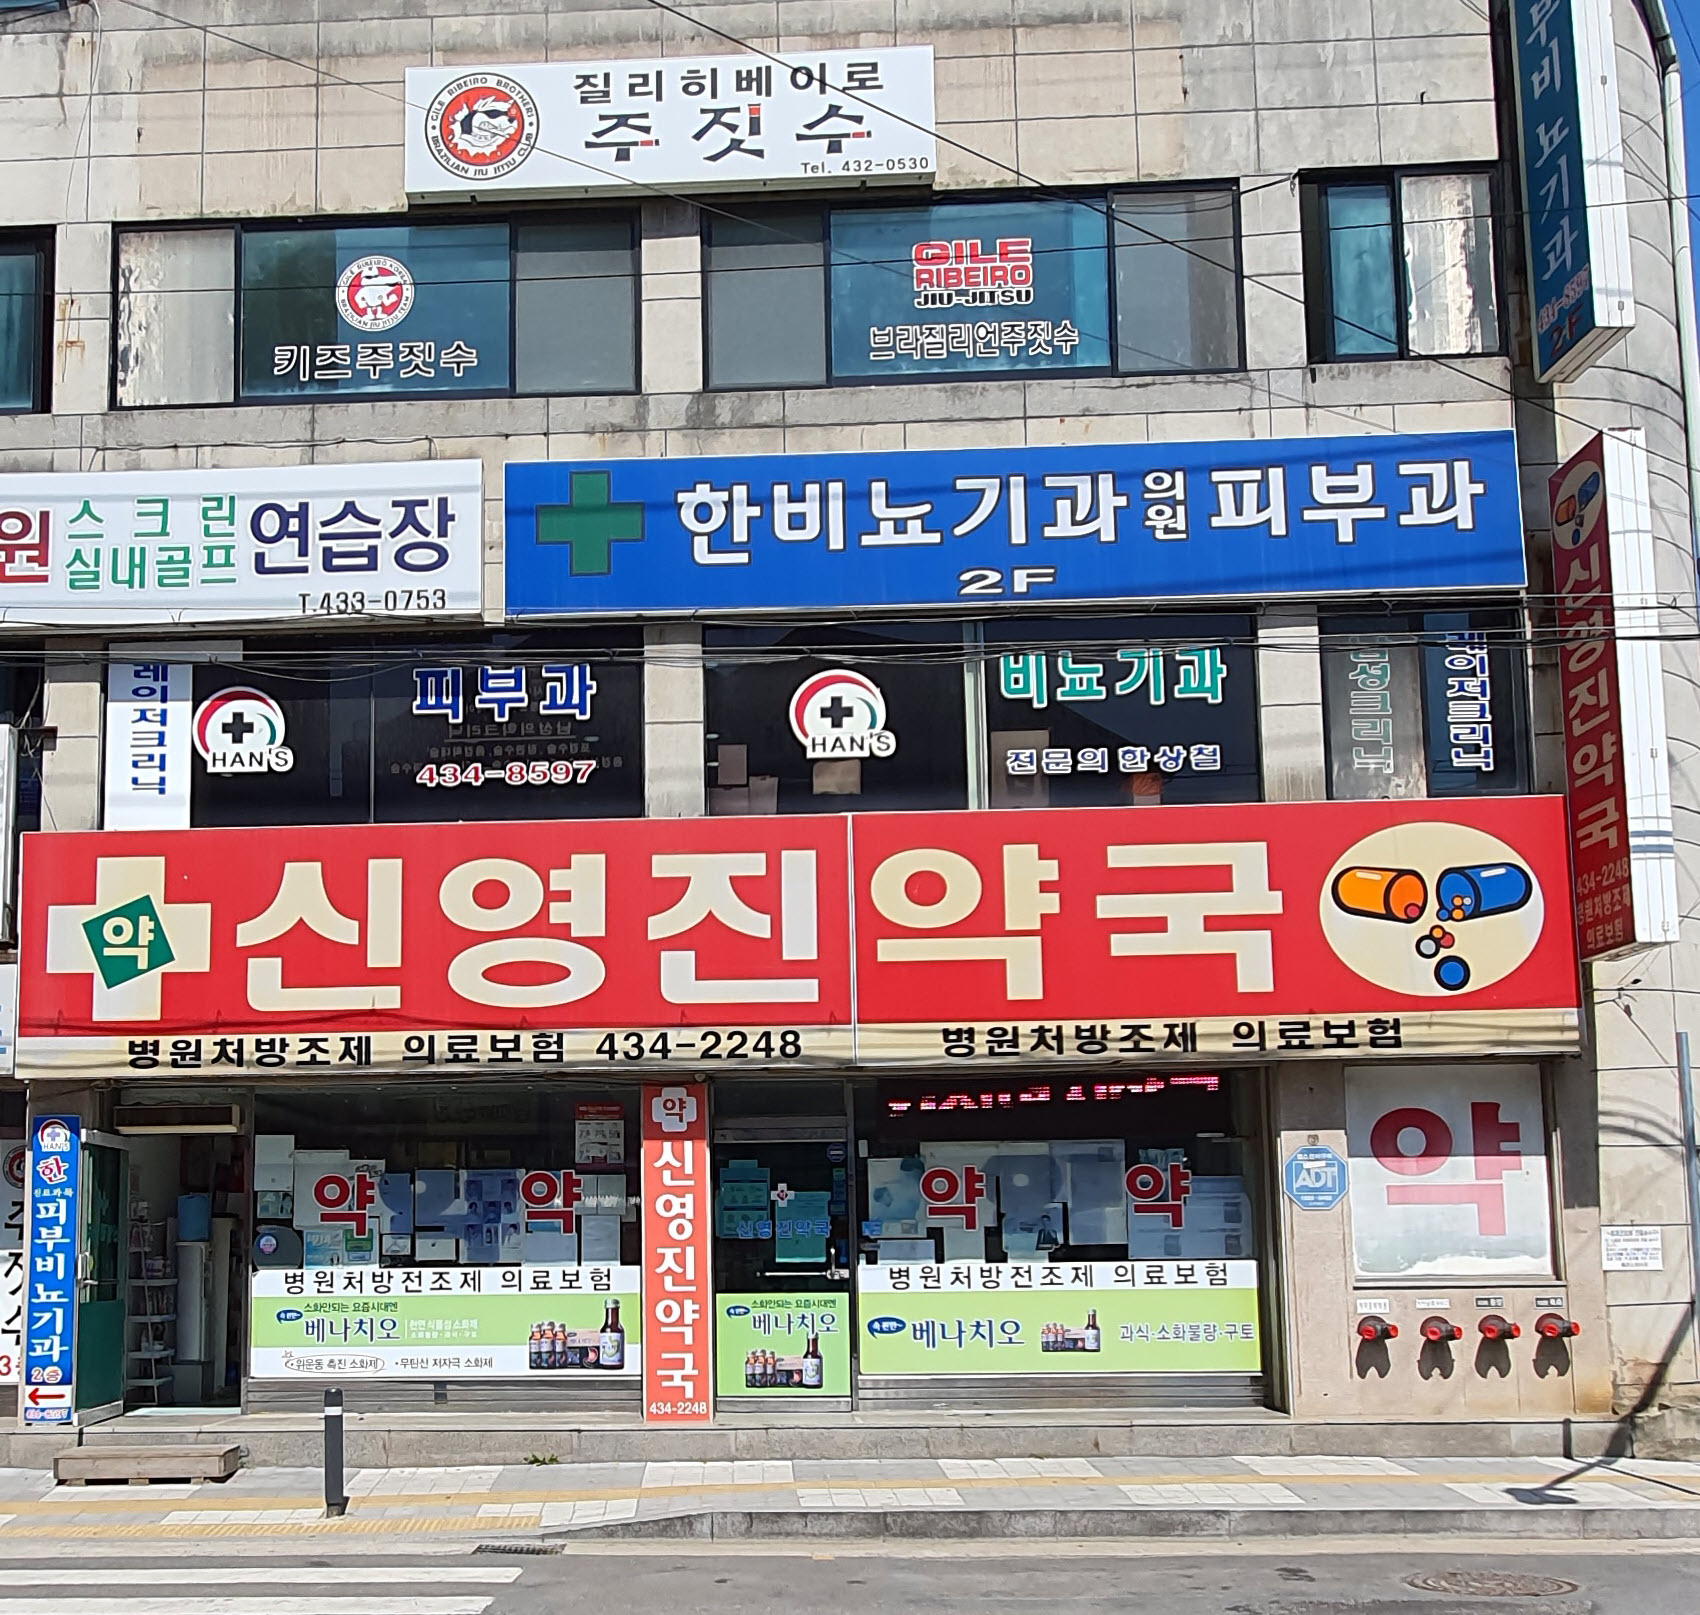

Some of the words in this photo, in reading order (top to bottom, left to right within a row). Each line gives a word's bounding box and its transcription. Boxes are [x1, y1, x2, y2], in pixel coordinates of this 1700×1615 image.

[447, 77, 488, 97] RIBEIRO
[573, 61, 884, 104] 질리히베이로
[584, 102, 872, 163] 주짓수
[431, 135, 469, 174] BRAZILIAN
[473, 168, 488, 176] JIU
[801, 161, 833, 175] Tel.
[842, 156, 930, 173] 432-0530
[912, 237, 1033, 267] GILE
[913, 263, 1033, 291] RIBEIRO
[914, 287, 1034, 308] JIU-JITSU
[869, 319, 1080, 361] 브라질리언주짓수
[273, 340, 479, 382] 키즈주짓수
[67, 495, 237, 539] 스크린
[1209, 458, 1486, 545] 피부과
[0, 510, 51, 584] 원
[250, 496, 457, 575] 연습장
[64, 543, 238, 590] 실내골프
[956, 566, 1057, 596] 2F
[412, 664, 597, 723] 피부과
[1000, 647, 1227, 708] 비뇨기과
[212, 747, 289, 768] HAN'S
[811, 732, 892, 753] HAN'S
[1007, 748, 1109, 775] 전문의
[1118, 744, 1221, 772] 한상철
[416, 760, 597, 787] 434-8597
[1576, 856, 1630, 897] 434-2248
[101, 914, 156, 969] 약
[235, 841, 1283, 1012] 신영진약국
[1586, 917, 1624, 950] 의료보험
[128, 1038, 372, 1070] 병원처방조제
[402, 1032, 567, 1065] 의료보험
[595, 1029, 803, 1062] 434-2248
[941, 1021, 1199, 1057] 병원처방조제
[1232, 1017, 1403, 1051] 의료보험
[663, 1098, 687, 1123] 약
[37, 1156, 69, 1183] 한
[1295, 1166, 1337, 1188] ADT
[1370, 1102, 1522, 1236] 약
[312, 1172, 376, 1238] 약
[520, 1170, 583, 1235] 약
[920, 1165, 986, 1231] 약
[1125, 1163, 1192, 1229] 약
[28, 1198, 71, 1363] 피부비뇨기과
[284, 1269, 481, 1295] 병원처방전조제
[500, 1268, 612, 1292] 의료보험
[653, 1140, 701, 1399] 신영진약국
[889, 1264, 1094, 1290] 병원처방전조제
[1113, 1263, 1228, 1287] 의료보험
[304, 1317, 401, 1343] 베나치오
[752, 1313, 839, 1335] 베나치오
[911, 1319, 1025, 1349] 베나치오
[432, 1357, 461, 1369] 저자극
[464, 1356, 493, 1369] 소화제
[649, 1401, 707, 1415] 434-2248
